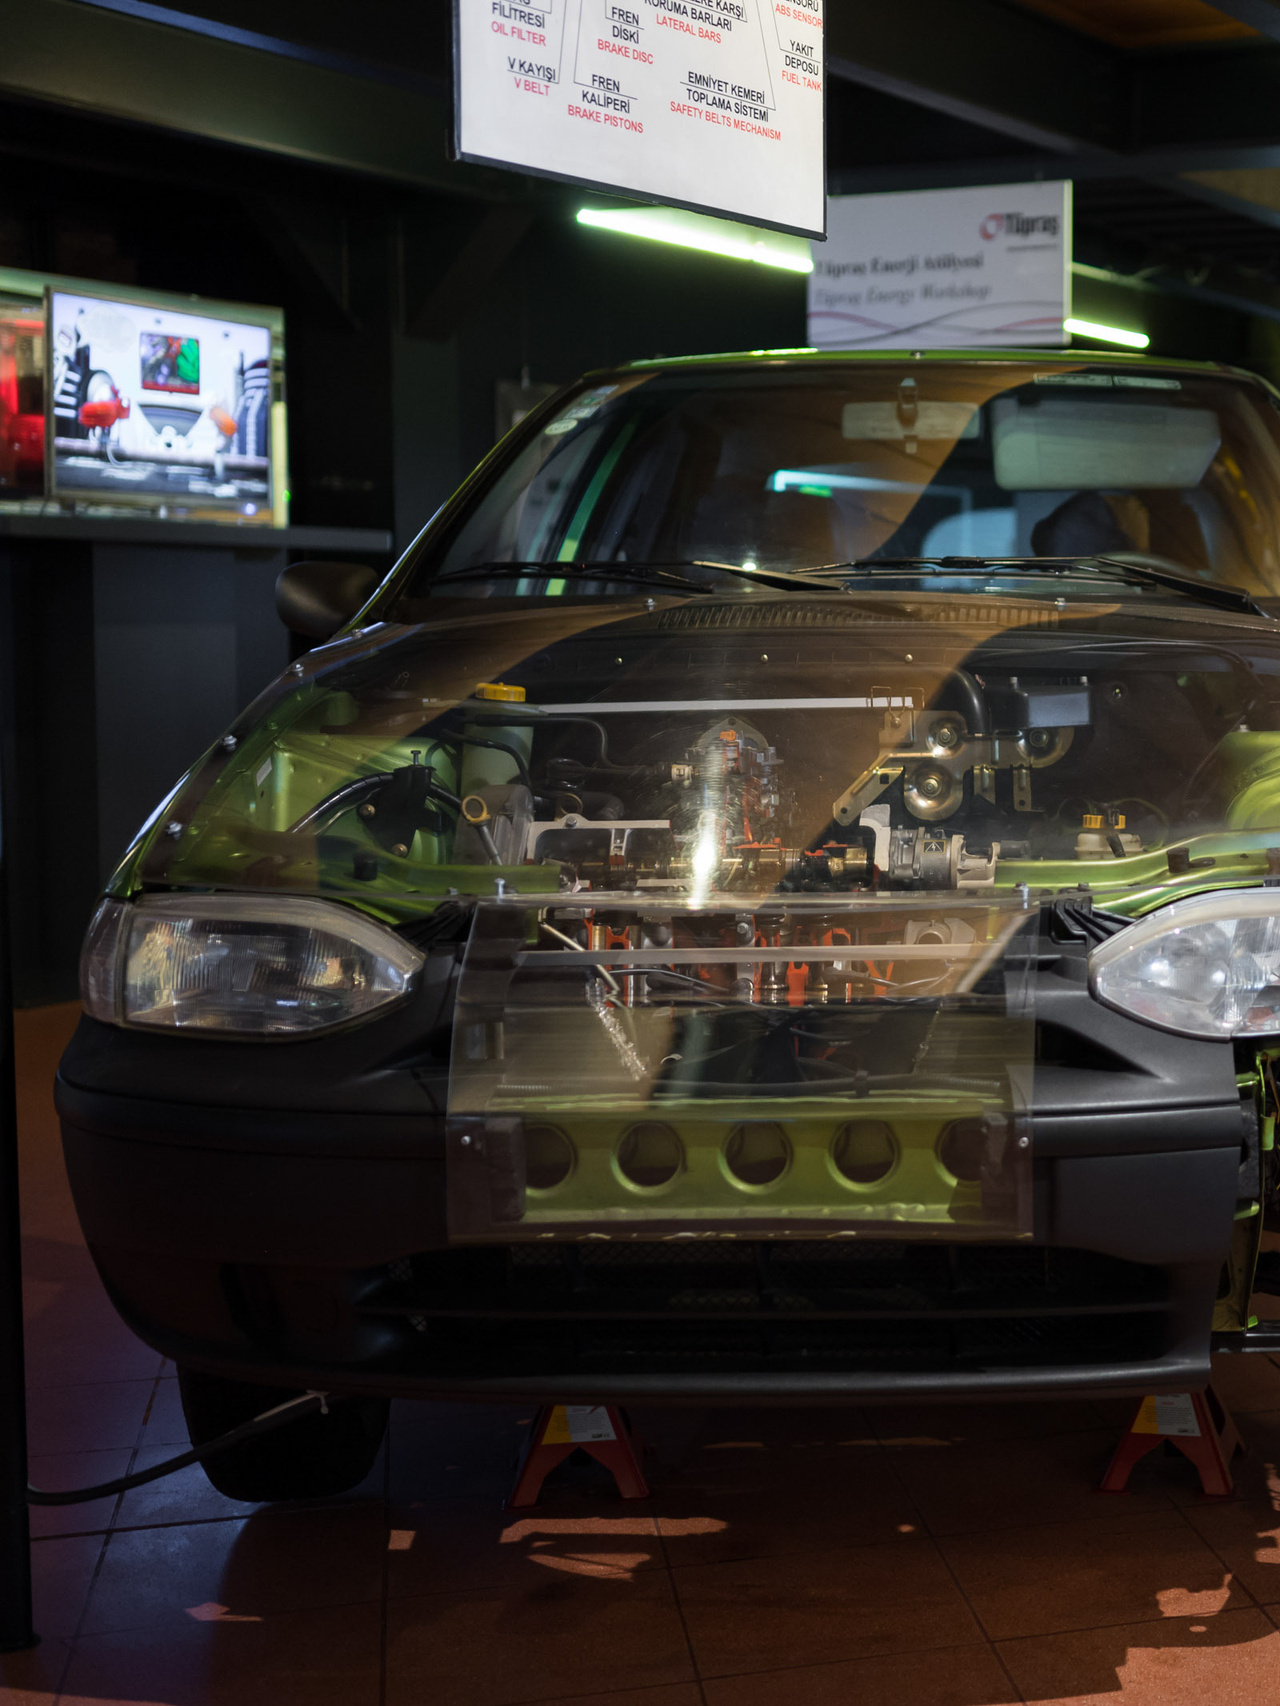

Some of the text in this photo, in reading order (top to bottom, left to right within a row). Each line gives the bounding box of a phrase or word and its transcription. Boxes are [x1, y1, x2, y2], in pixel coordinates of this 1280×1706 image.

[611, 6, 640, 26] FREN
[656, 13, 722, 44] LATERAL BARS
[691, 7, 732, 32] BARLARI
[775, 3, 823, 29] ABS SENSOR
[491, 21, 546, 47] OIL FILTER
[612, 25, 640, 44] DİSKİ
[597, 38, 654, 65] BRAKE DISC
[789, 39, 814, 58] YAKIT
[508, 56, 556, 82] V KAYIŞI
[785, 55, 819, 76] DEPOSU
[514, 77, 550, 97] V BELT
[592, 74, 620, 93] FREN
[688, 71, 765, 105] EMNİYET KEMERİ
[781, 70, 823, 92] FUEL TANK
[582, 89, 630, 114] KALİPERİ
[686, 88, 769, 123] TOPLAMA SİSTEMİ
[567, 104, 643, 134] BRAKE PISTONS
[670, 101, 781, 141] SAFETY BELTS MECHANISM
